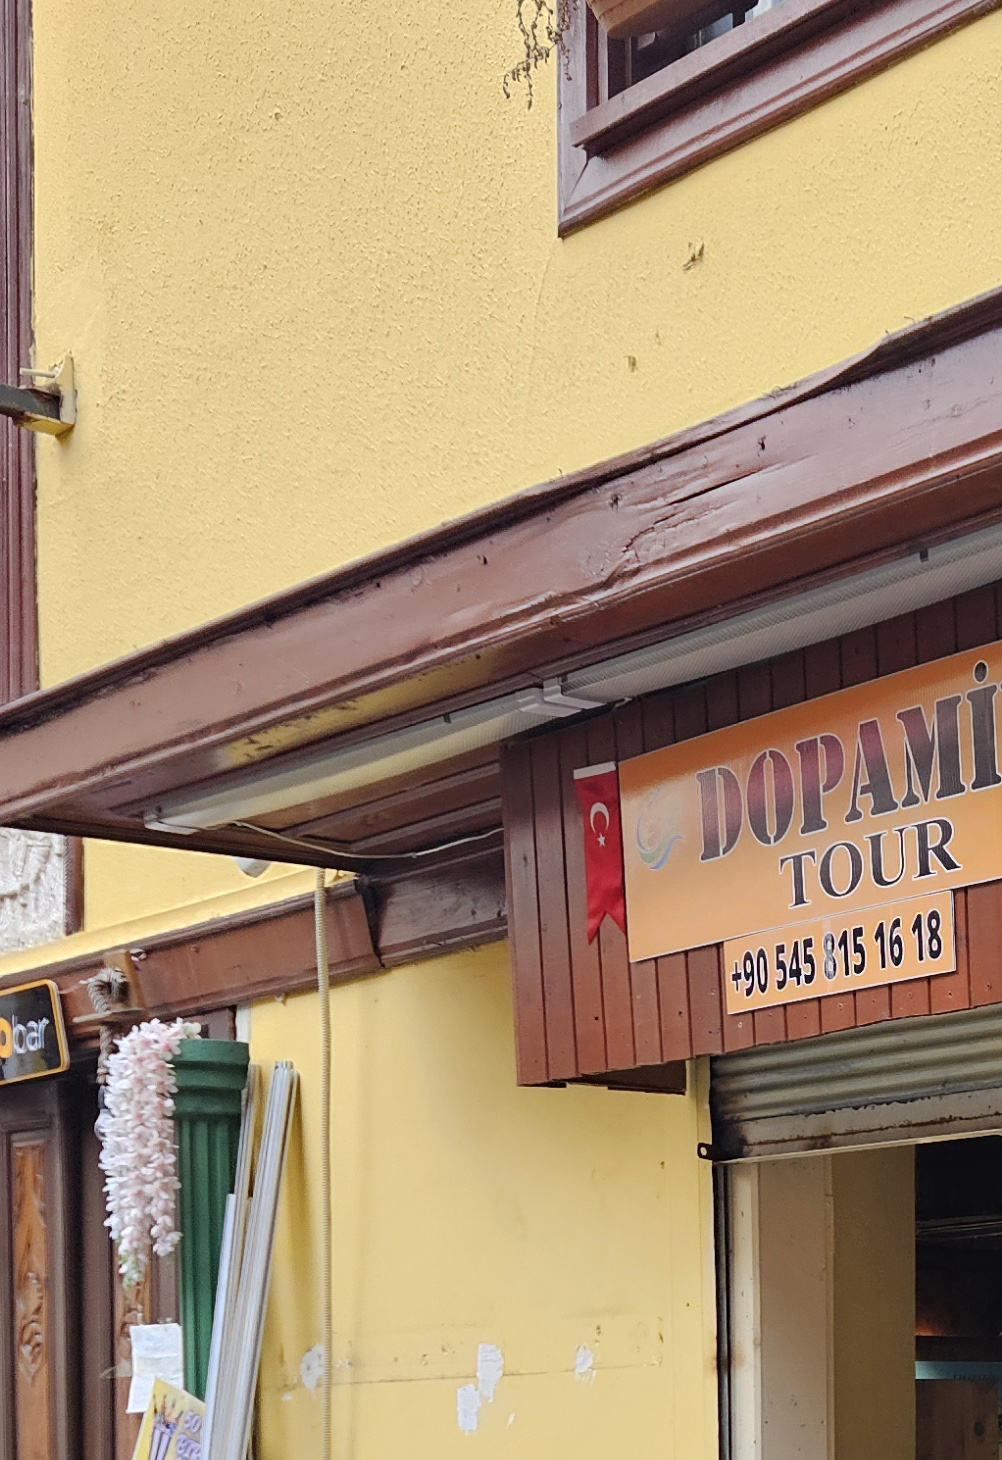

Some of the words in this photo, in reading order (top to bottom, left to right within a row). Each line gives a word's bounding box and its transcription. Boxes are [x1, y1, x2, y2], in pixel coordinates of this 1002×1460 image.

[779, 817, 962, 909] TOUR
[732, 947, 769, 997] +90
[775, 937, 816, 990] 545
[822, 926, 866, 980] 815
[874, 917, 903, 970] 16
[911, 909, 943, 961] 18
